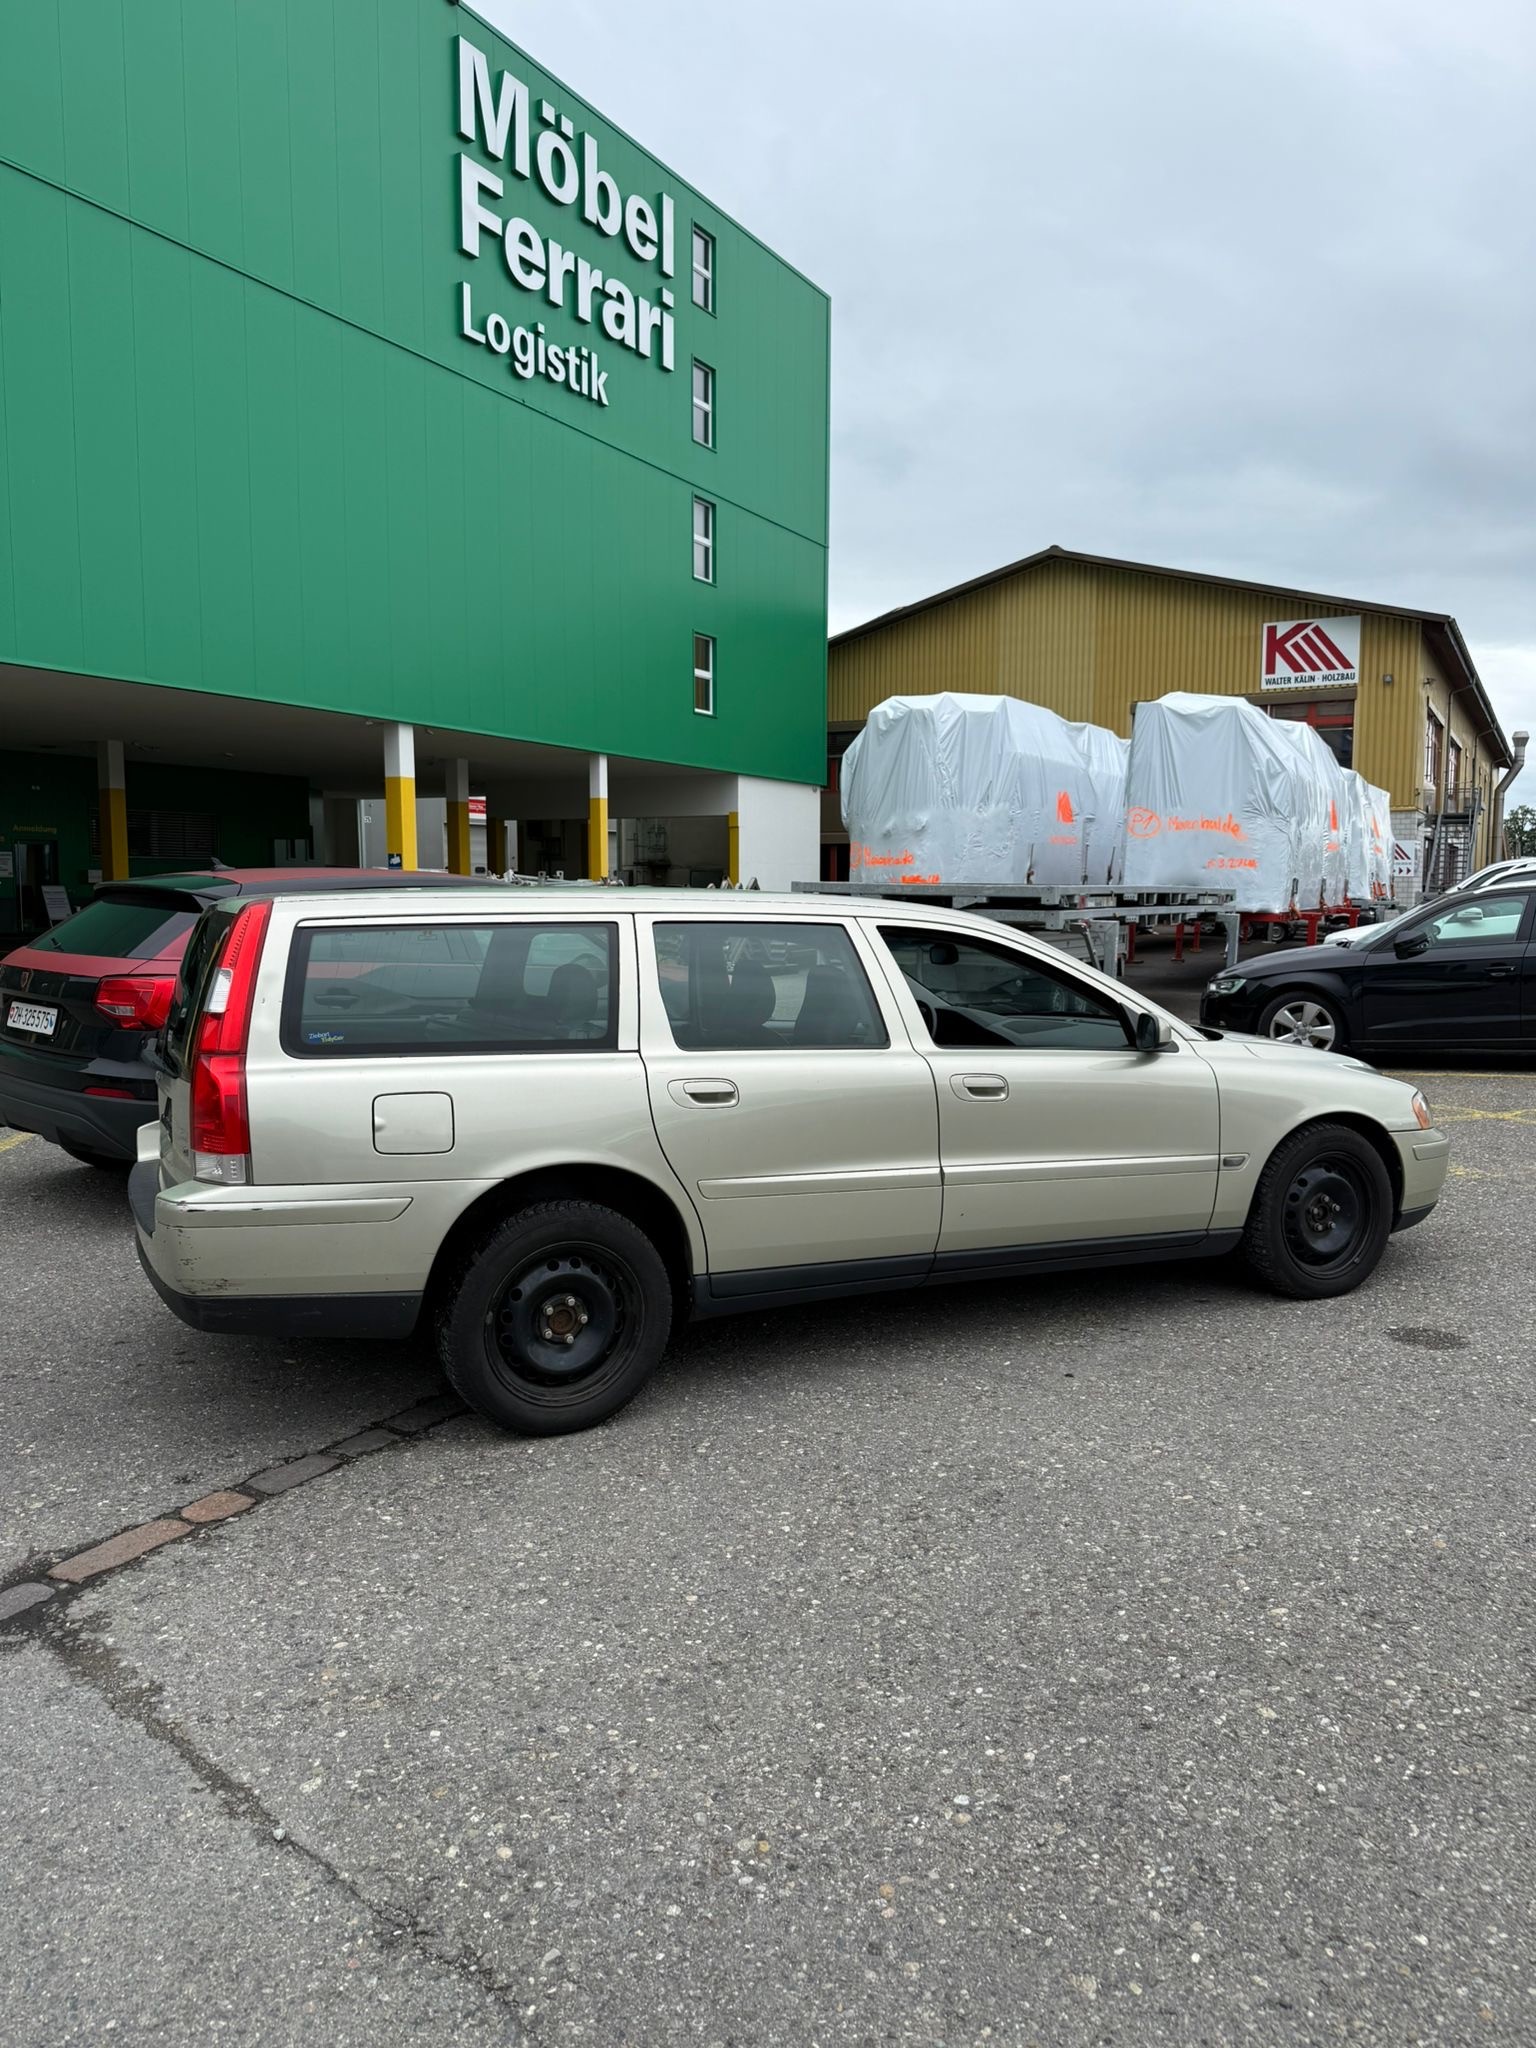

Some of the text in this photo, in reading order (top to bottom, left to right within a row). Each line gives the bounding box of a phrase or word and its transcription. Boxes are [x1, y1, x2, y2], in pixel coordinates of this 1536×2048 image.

[456, 34, 674, 278] Möbel
[457, 152, 675, 372] Ferrari
[459, 281, 609, 407] Logistik
[1264, 672, 1356, 686] WALTER KÄLIN HOLZBAU
